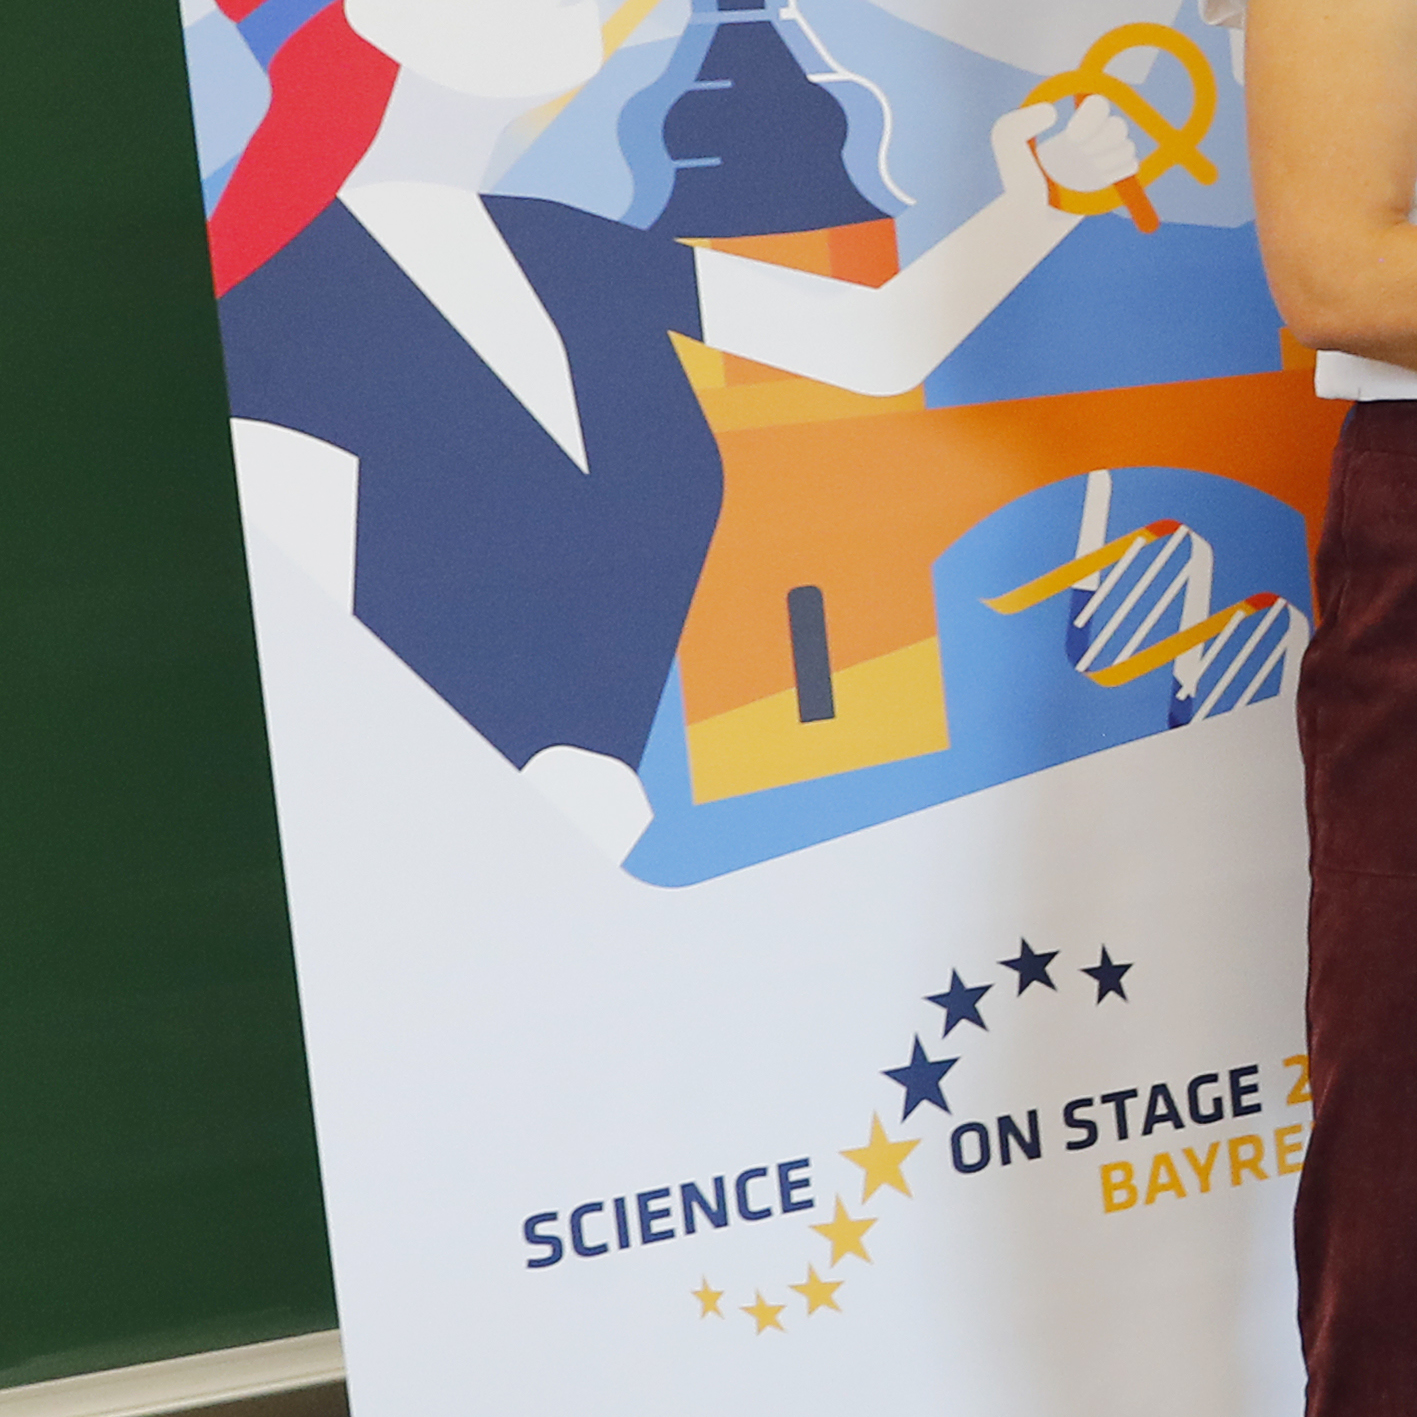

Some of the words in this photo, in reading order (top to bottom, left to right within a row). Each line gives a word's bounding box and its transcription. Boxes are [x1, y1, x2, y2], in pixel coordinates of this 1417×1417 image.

[523, 1157, 816, 1269] SCIENCE
[948, 1109, 1041, 1175] ON
[1063, 1064, 1262, 1152] STAGE
[1100, 1122, 1308, 1214] BAYRE
